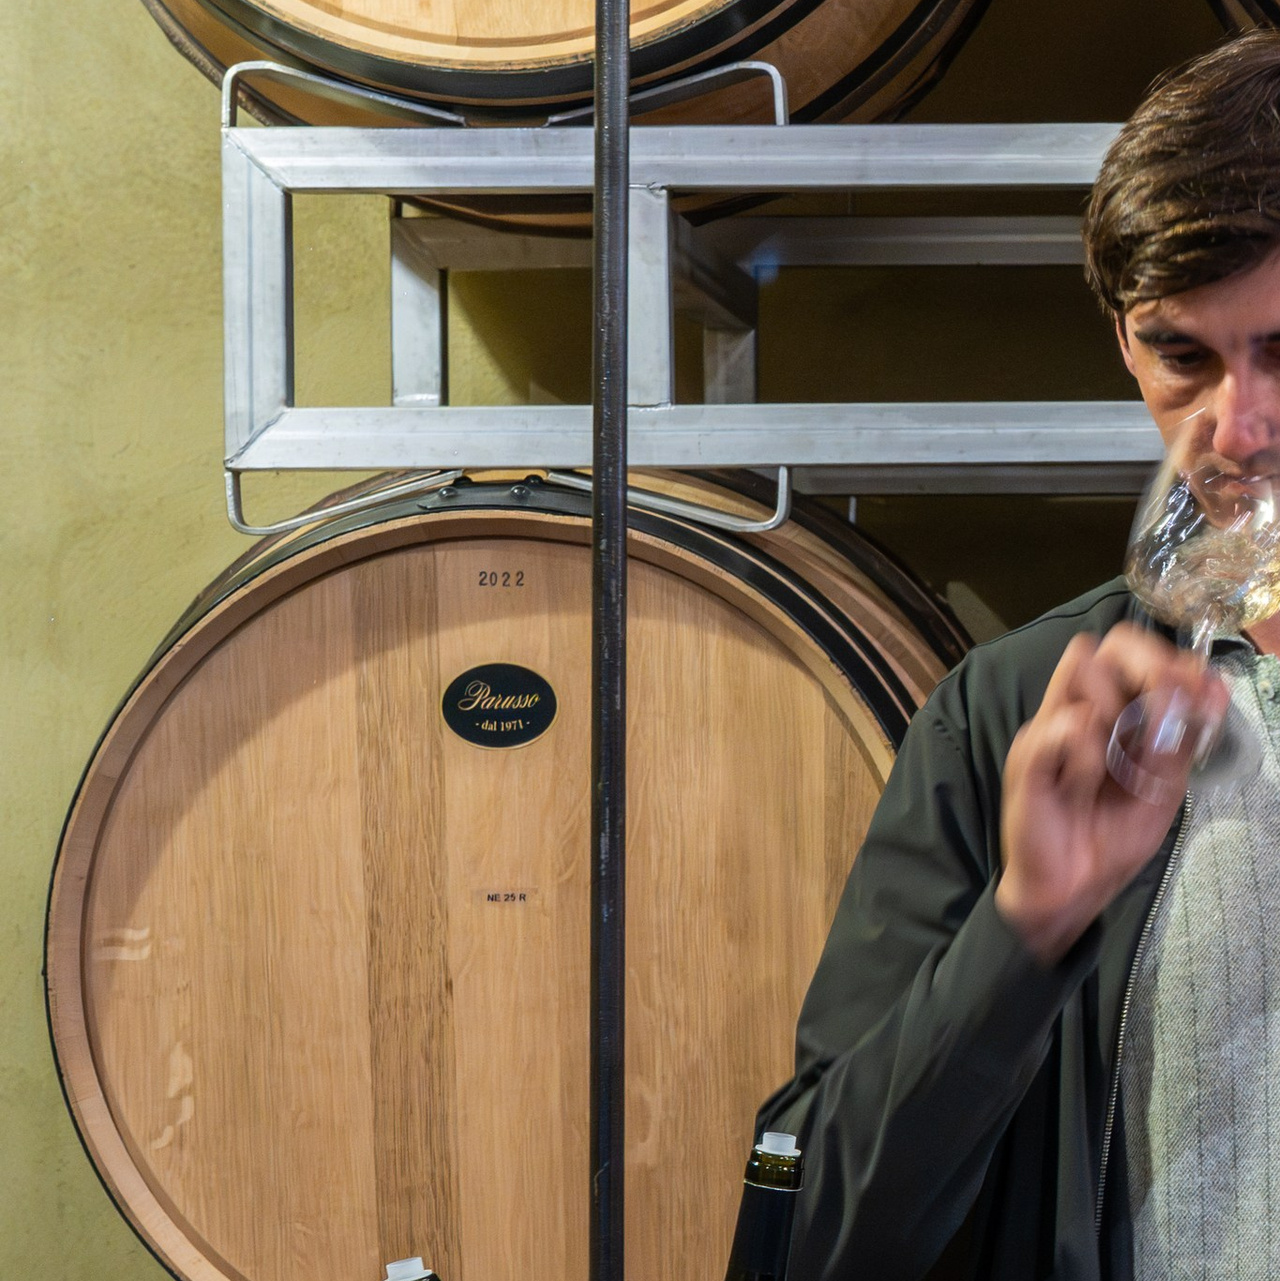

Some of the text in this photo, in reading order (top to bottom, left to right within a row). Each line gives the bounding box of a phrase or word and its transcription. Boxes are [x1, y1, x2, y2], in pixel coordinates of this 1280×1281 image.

[479, 570, 525, 587] 2022
[458, 680, 541, 711] Parusso
[481, 719, 524, 732] dal 1971
[519, 893, 527, 902] R
